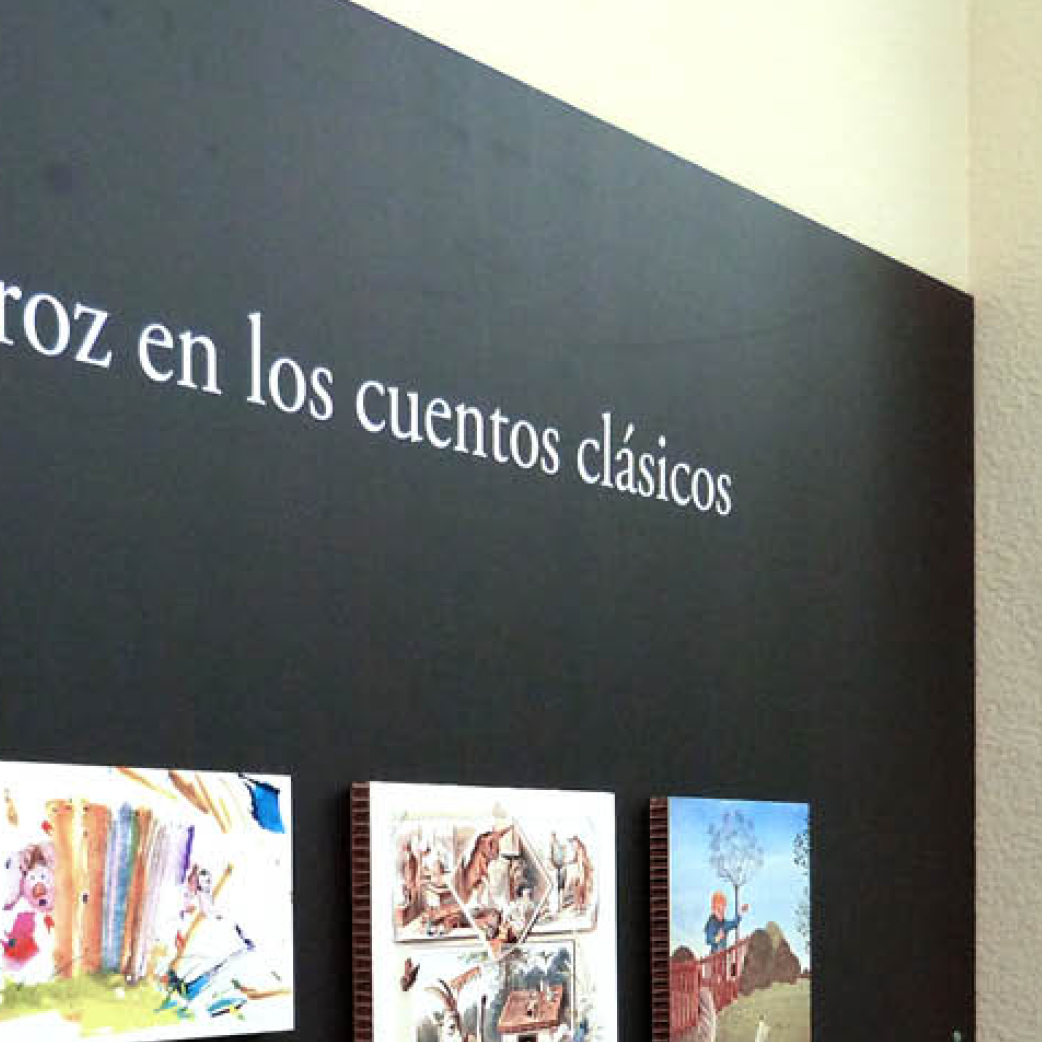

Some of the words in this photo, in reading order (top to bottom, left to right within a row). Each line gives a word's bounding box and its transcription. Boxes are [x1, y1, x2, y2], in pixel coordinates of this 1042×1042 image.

[137, 322, 222, 395] en
[246, 311, 334, 421] los
[355, 380, 561, 476] cuentos
[576, 411, 732, 516] clásicos
